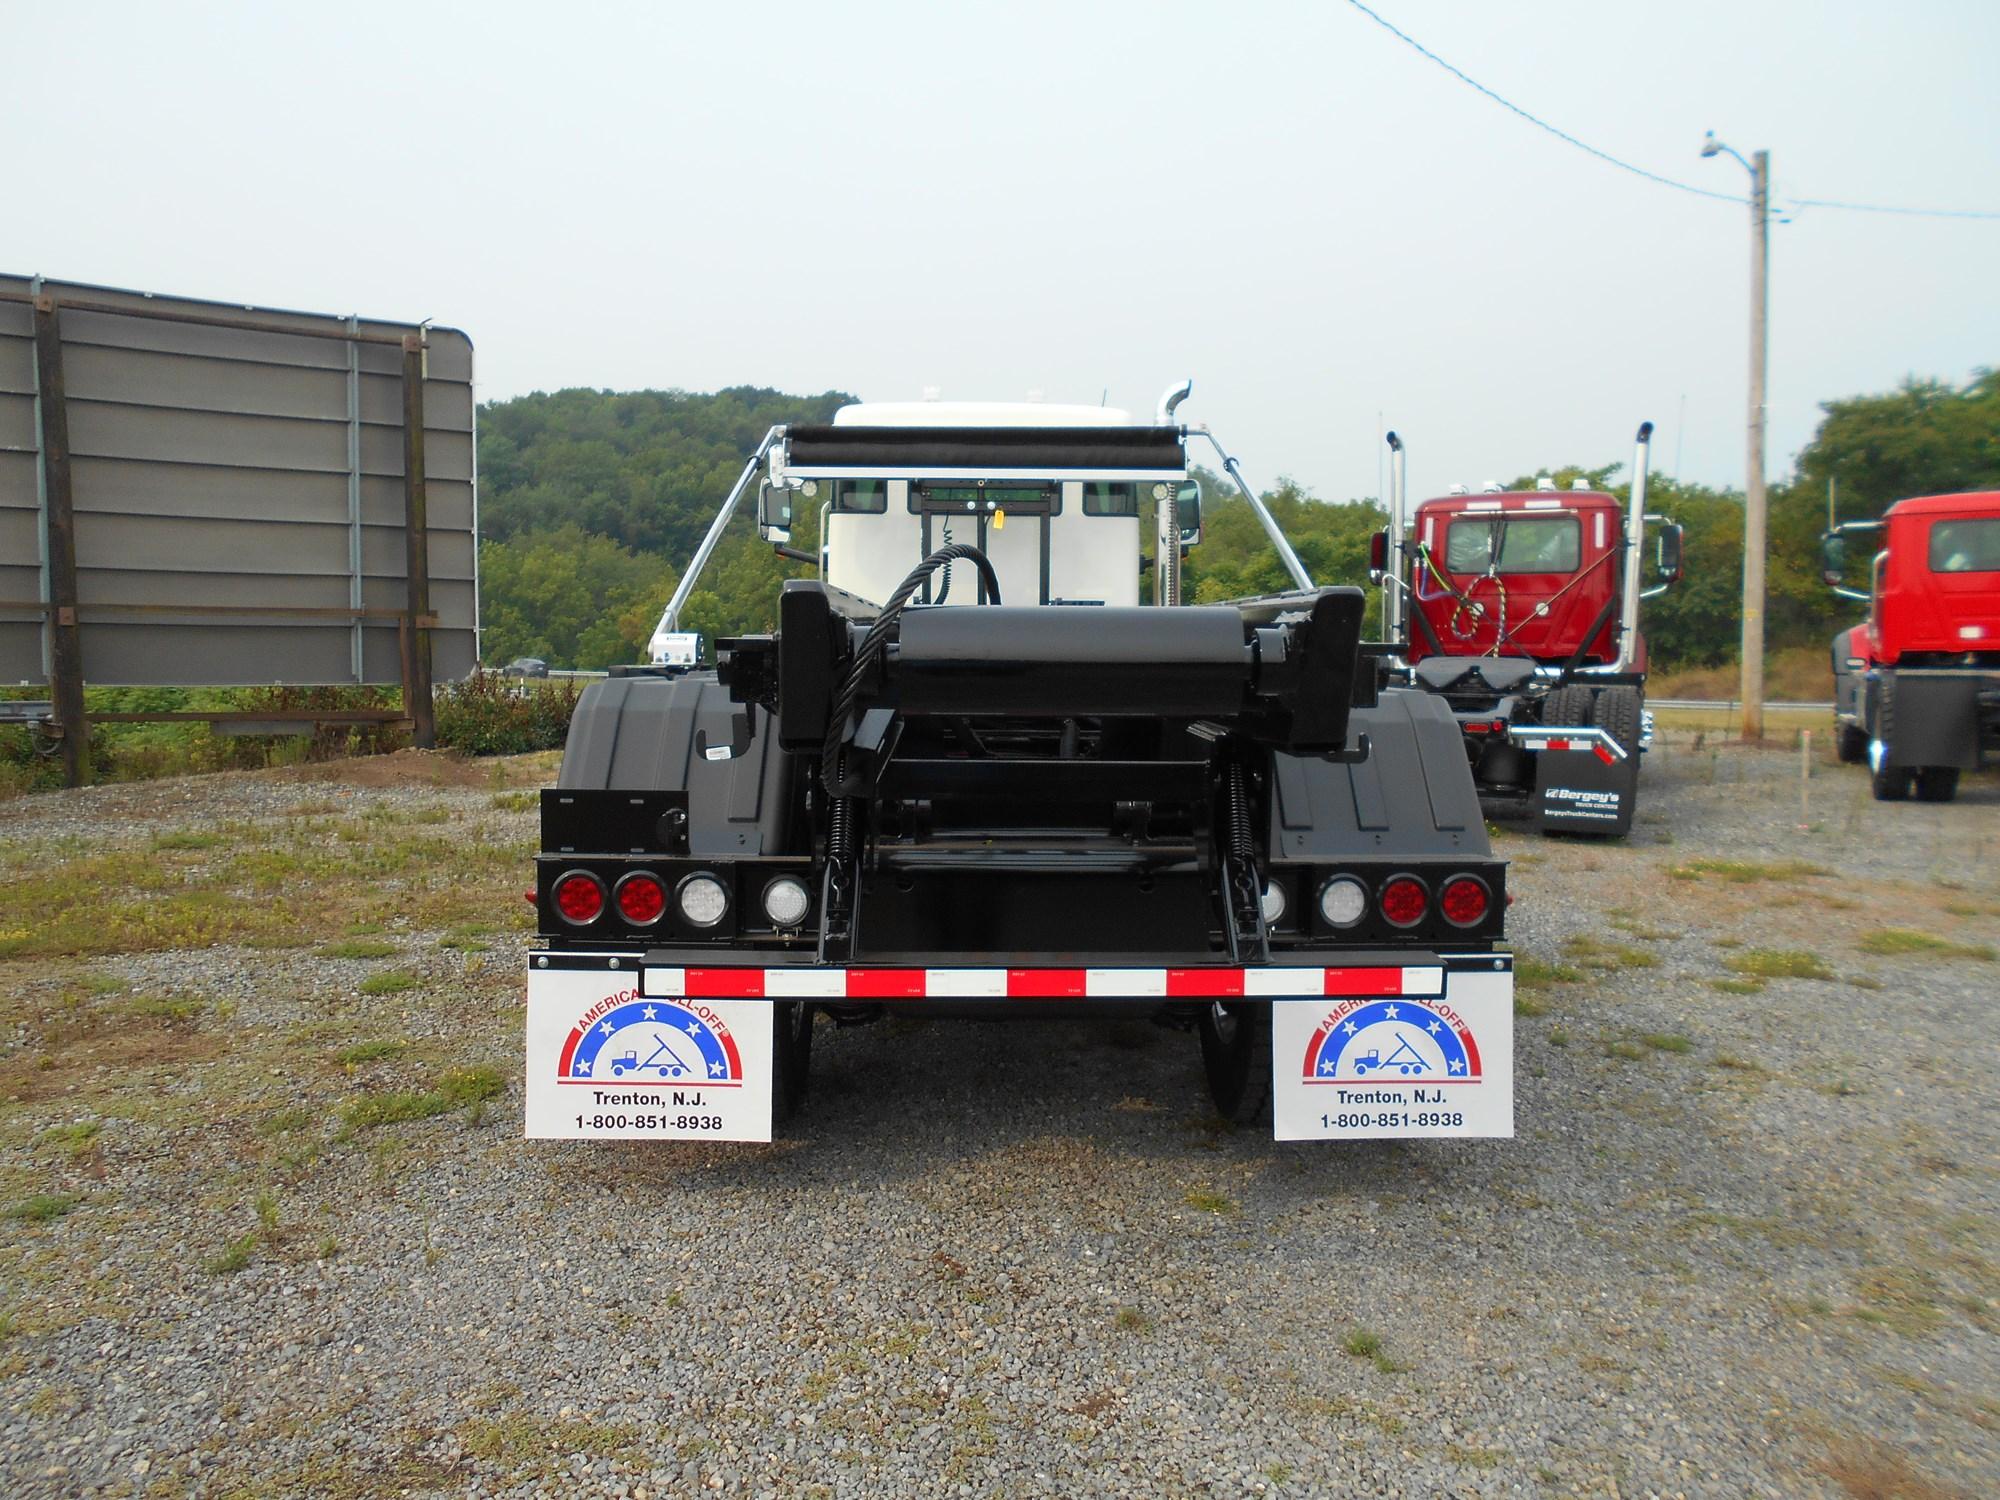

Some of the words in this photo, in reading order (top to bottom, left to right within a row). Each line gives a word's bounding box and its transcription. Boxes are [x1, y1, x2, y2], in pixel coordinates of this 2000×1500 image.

[1558, 789, 1619, 803] Bergey's
[578, 988, 641, 1031] AMERICA
[593, 1091, 666, 1108] Trenton,
[673, 1092, 707, 1106] N.J.
[1337, 1090, 1408, 1106] Trenton,
[1414, 1089, 1447, 1103] N.J.
[575, 1115, 723, 1130] 1-800-851-8938
[1321, 1113, 1463, 1128] 1-800-851-8938
